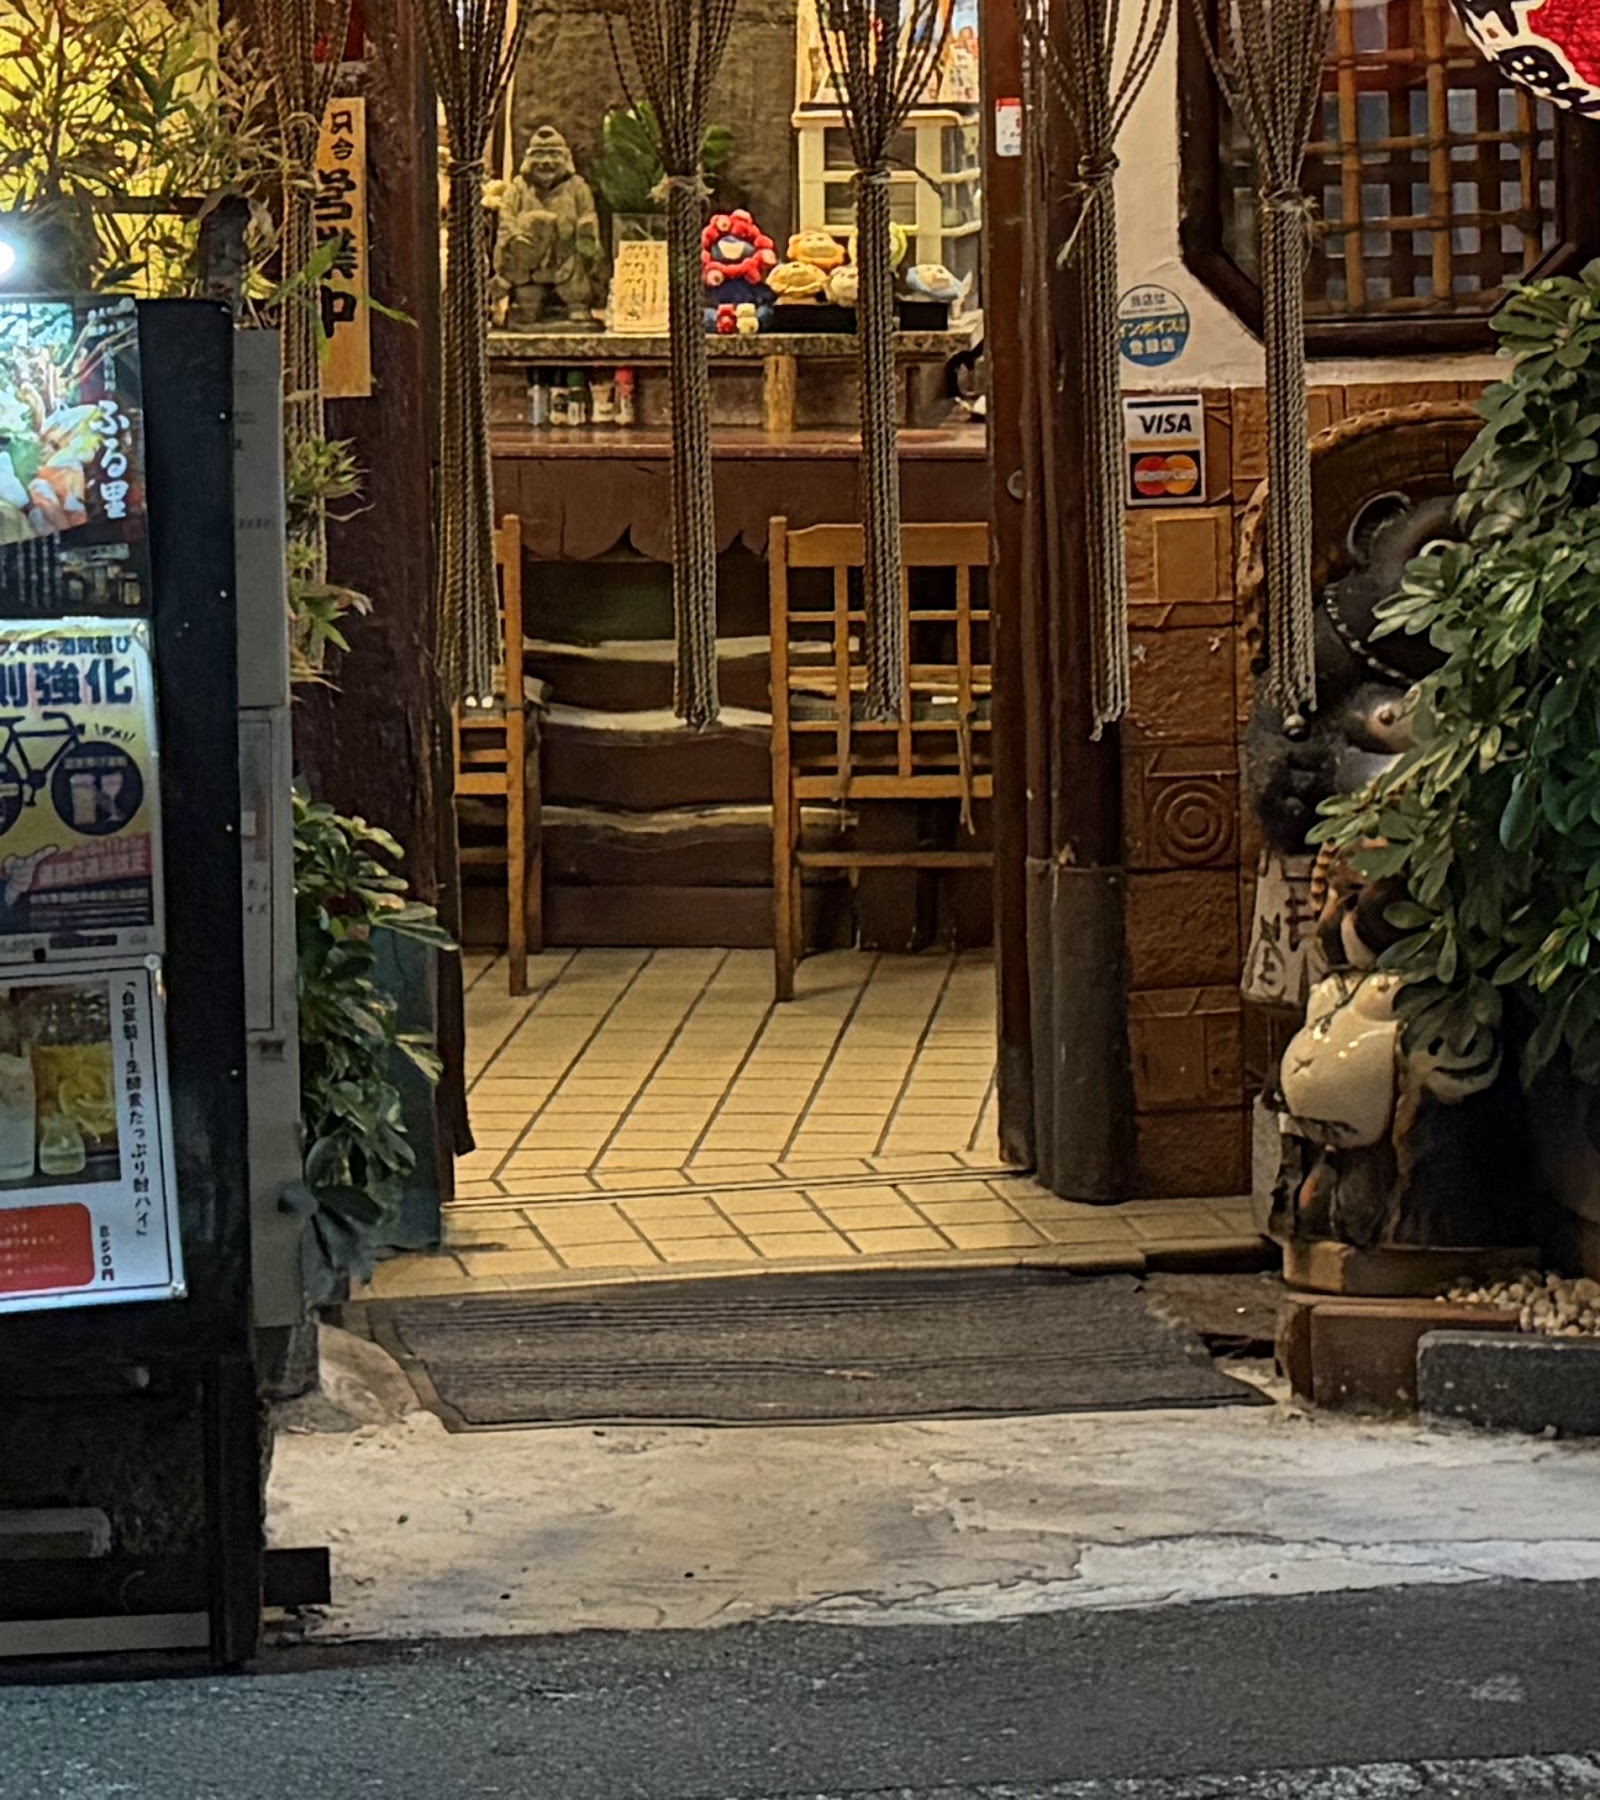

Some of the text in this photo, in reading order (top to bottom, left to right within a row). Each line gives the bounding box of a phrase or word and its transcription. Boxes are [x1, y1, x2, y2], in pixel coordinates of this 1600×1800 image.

[1139, 412, 1193, 434] VISA
[89, 399, 130, 519] ふる里
